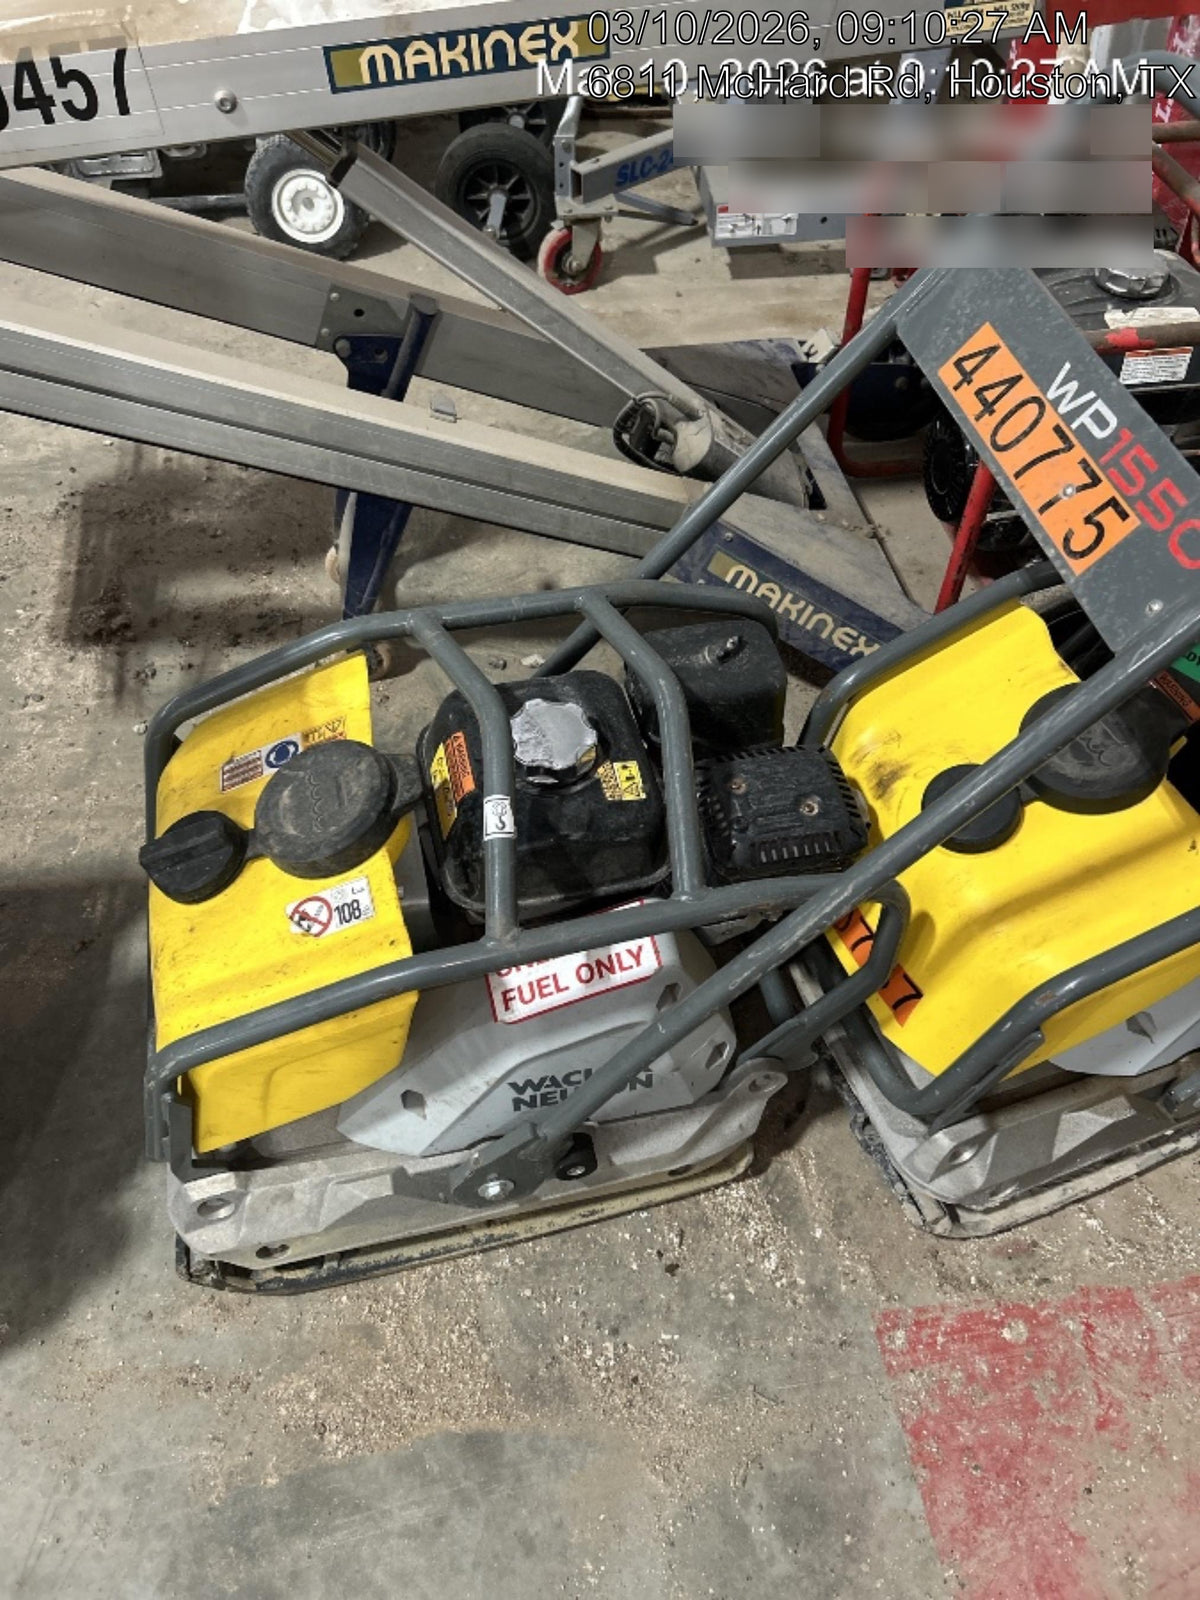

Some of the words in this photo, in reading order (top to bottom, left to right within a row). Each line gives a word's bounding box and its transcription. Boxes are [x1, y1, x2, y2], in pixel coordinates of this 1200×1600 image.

[359, 22, 579, 84] MAKINEX
[952, 343, 1130, 560] 440775
[725, 564, 881, 657] MAKINEX
[334, 899, 362, 925] 108
[500, 973, 570, 1013] FUEL
[575, 945, 643, 985] ONLY
